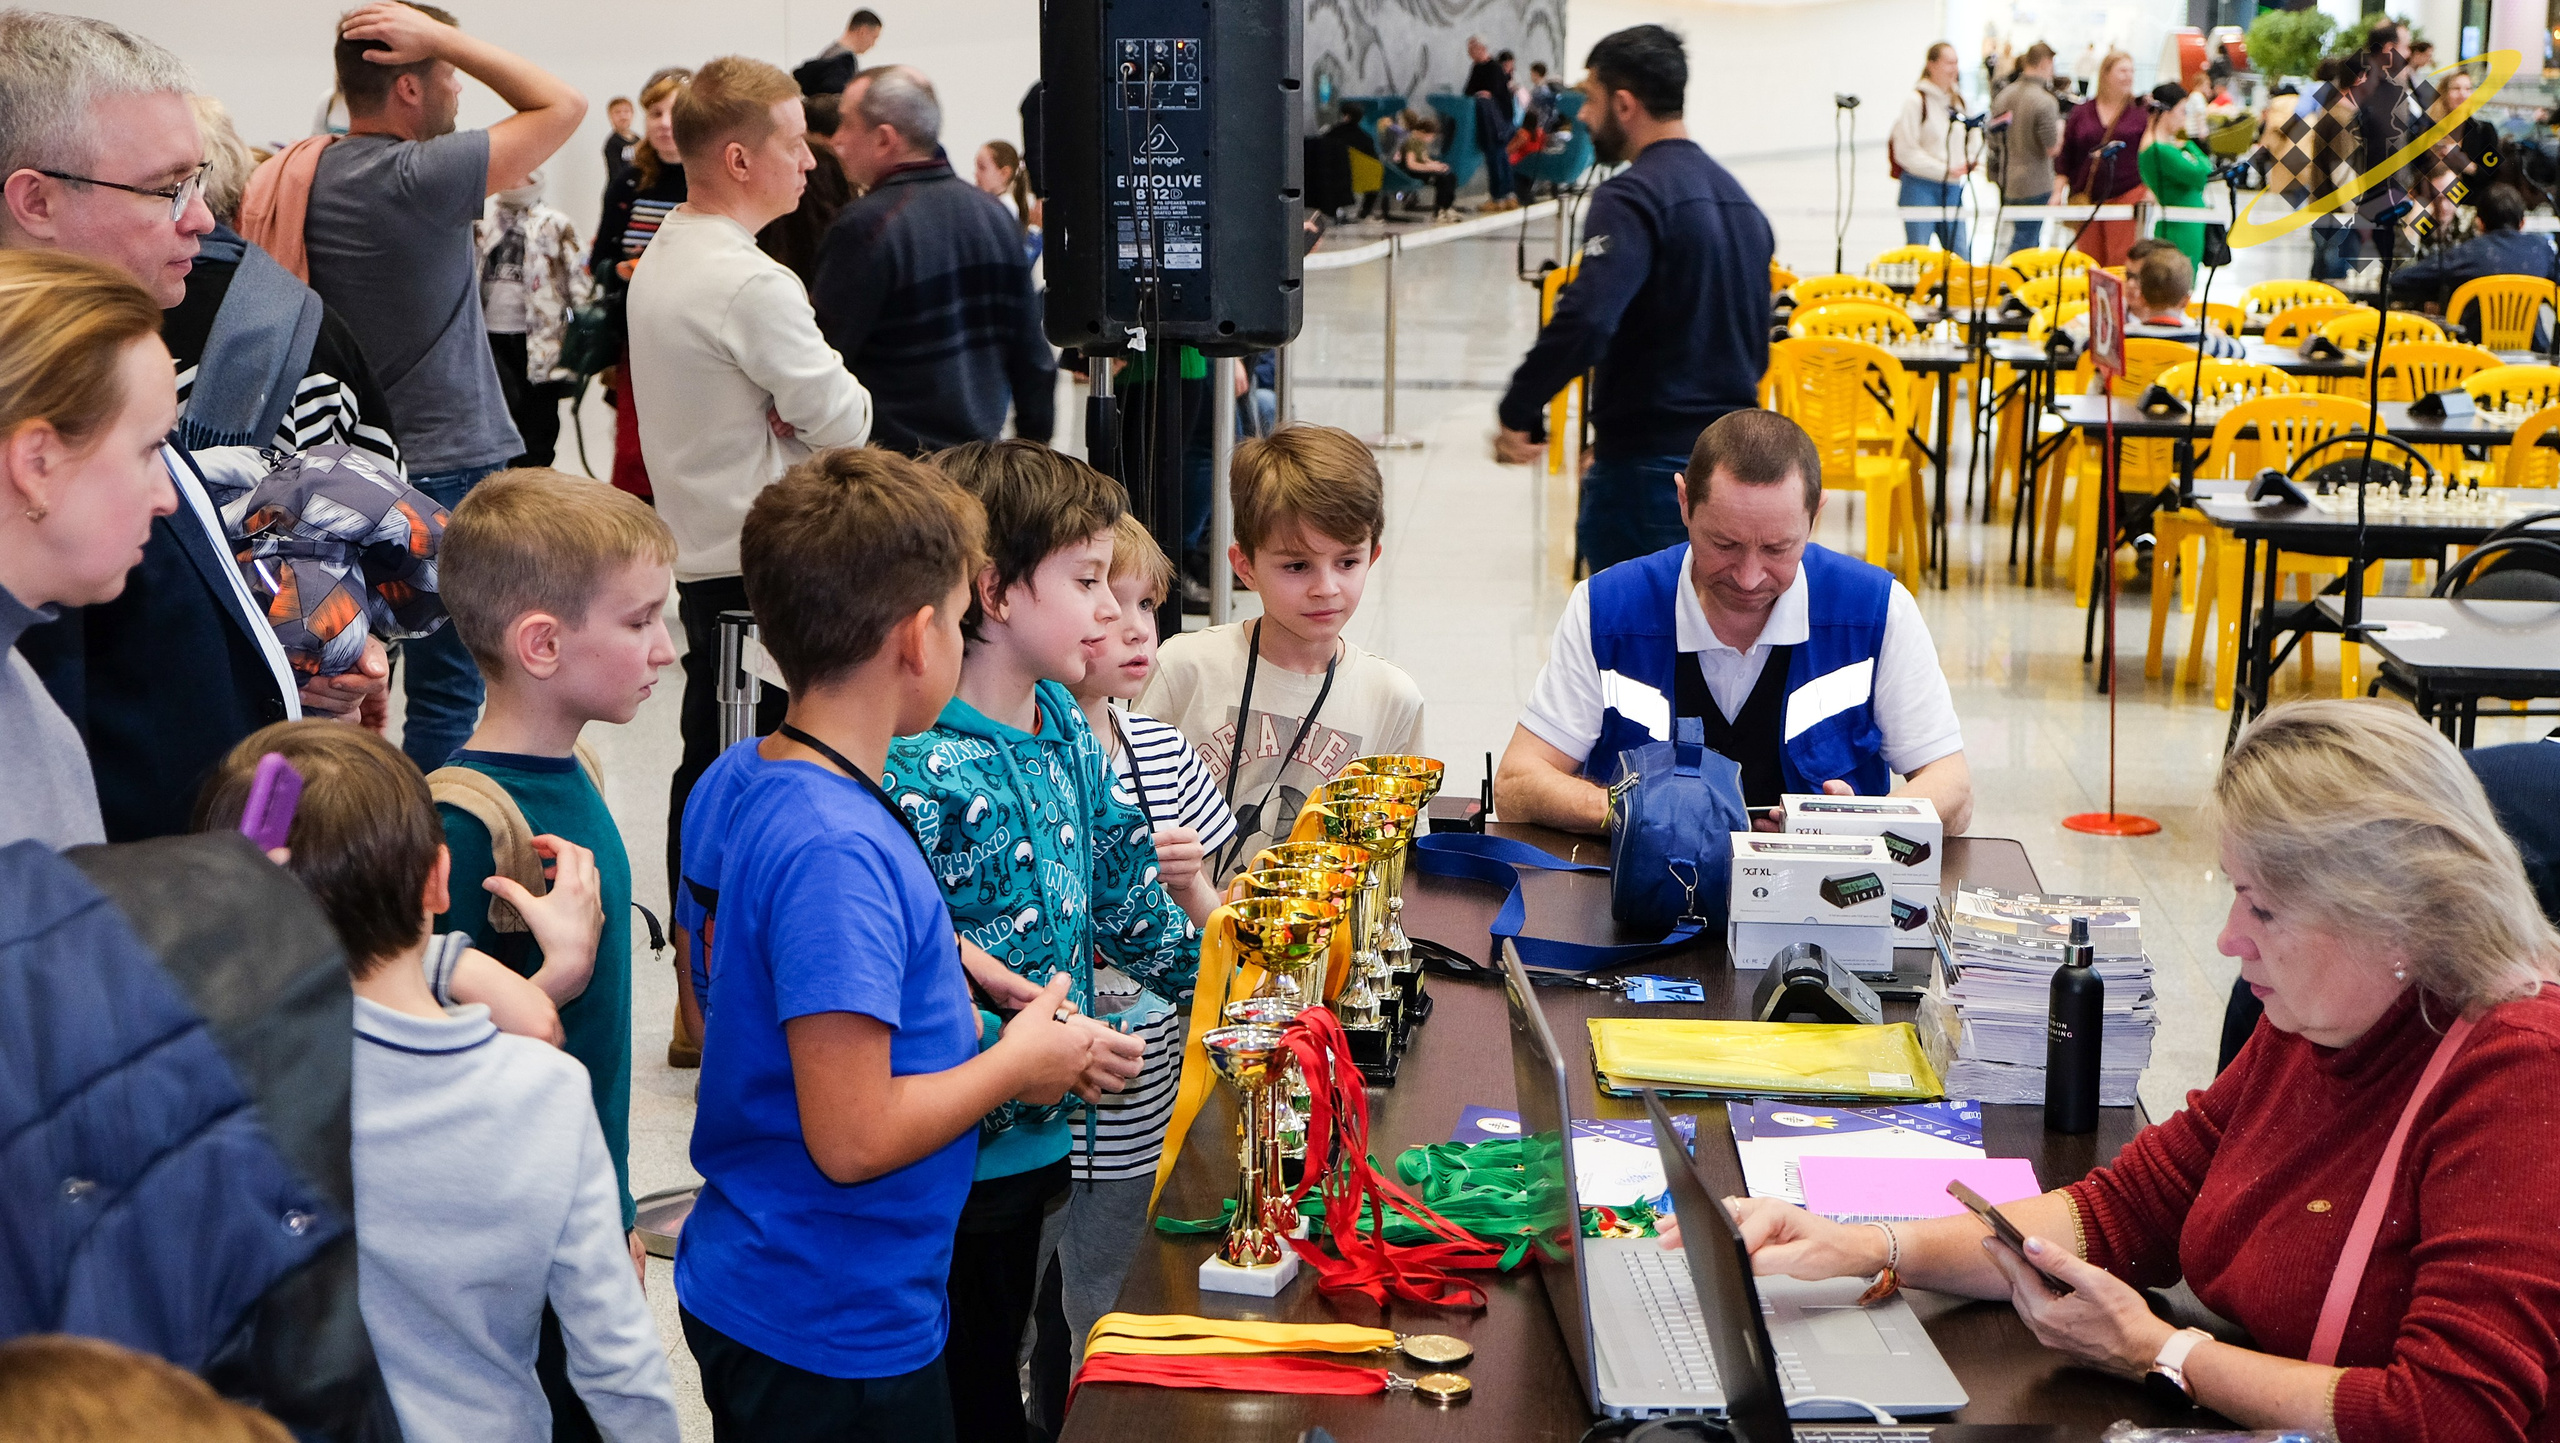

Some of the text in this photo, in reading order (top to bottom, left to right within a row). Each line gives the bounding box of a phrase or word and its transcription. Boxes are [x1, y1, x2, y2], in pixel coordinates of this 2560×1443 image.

[1117, 175, 1201, 188] EUROLIVE
[1196, 721, 1252, 786] BE
[1256, 713, 1281, 758] A
[932, 826, 1010, 879] IKHAND
[1742, 867, 1771, 876] DGT XL
